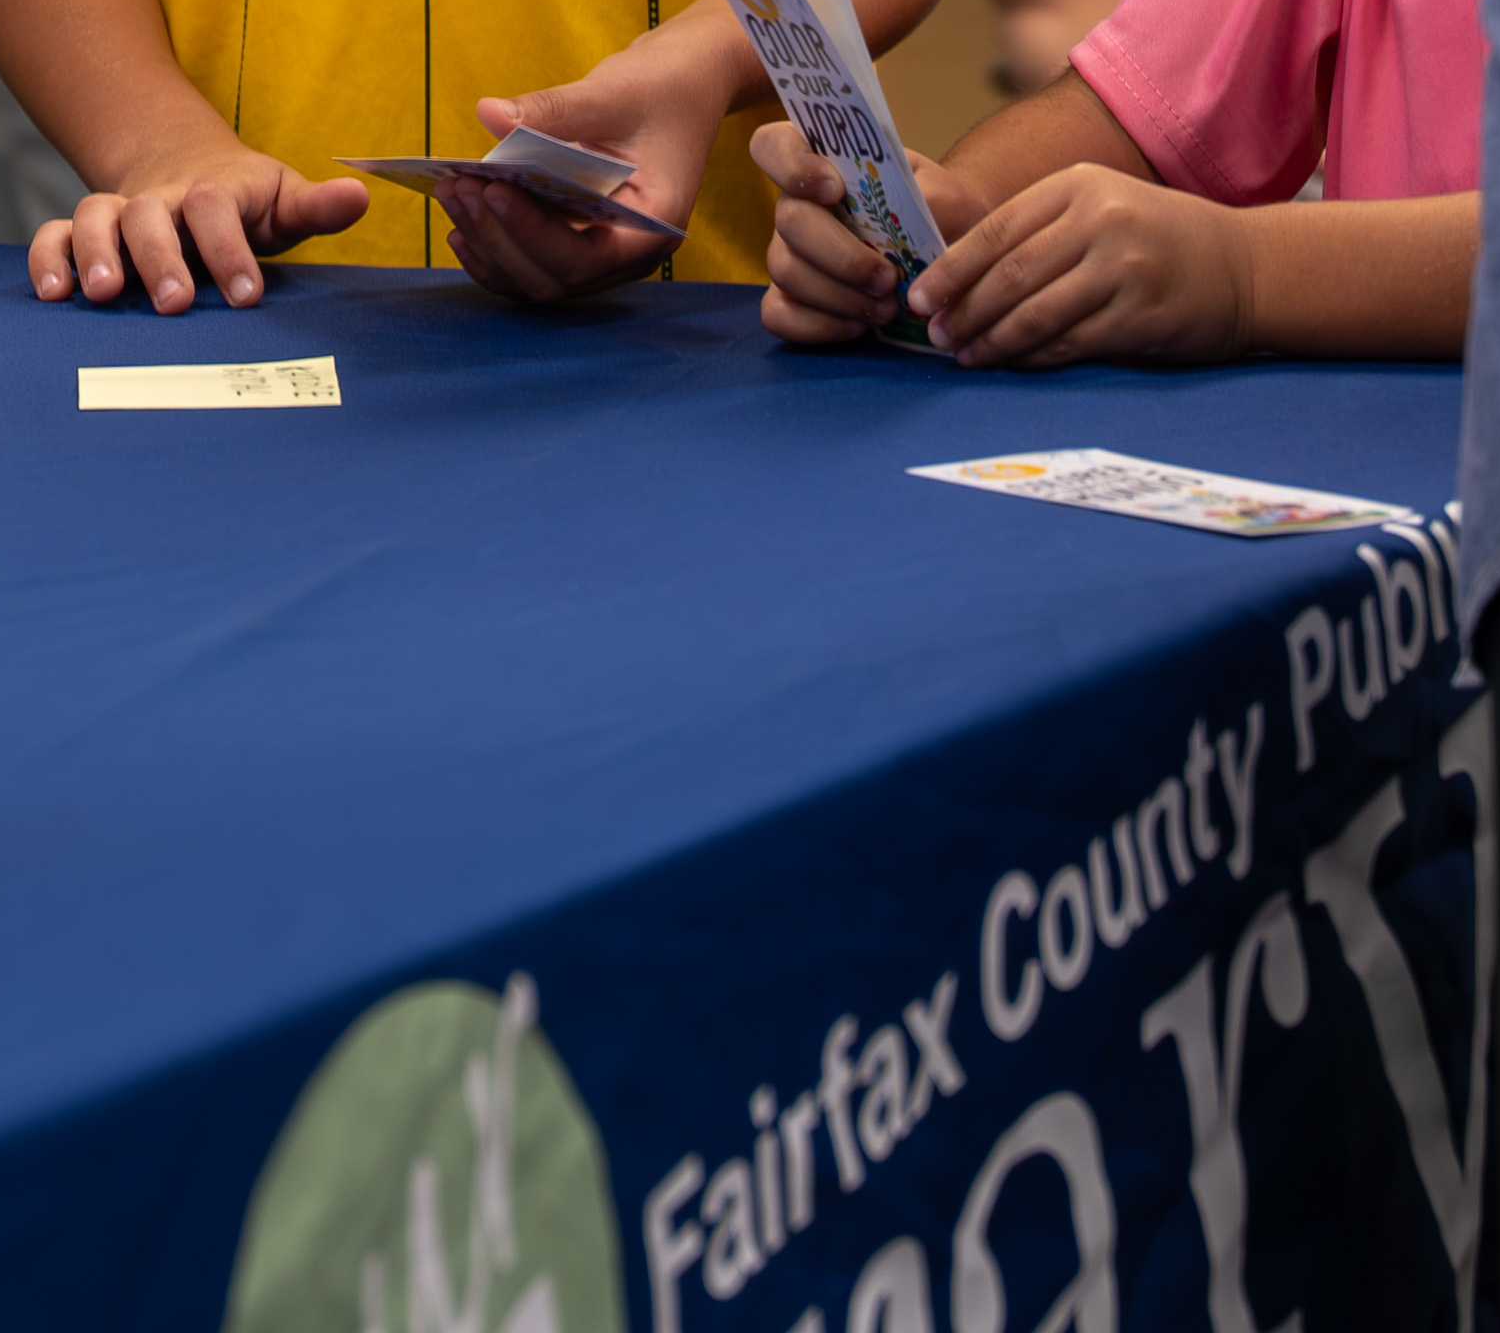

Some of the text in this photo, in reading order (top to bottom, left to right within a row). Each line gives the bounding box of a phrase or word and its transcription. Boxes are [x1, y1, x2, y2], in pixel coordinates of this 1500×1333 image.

[746, 13, 841, 75] COLOR
[792, 73, 839, 99] OUR
[789, 99, 884, 163] WORLD
[643, 499, 1465, 1333] Fairfax County Publi
